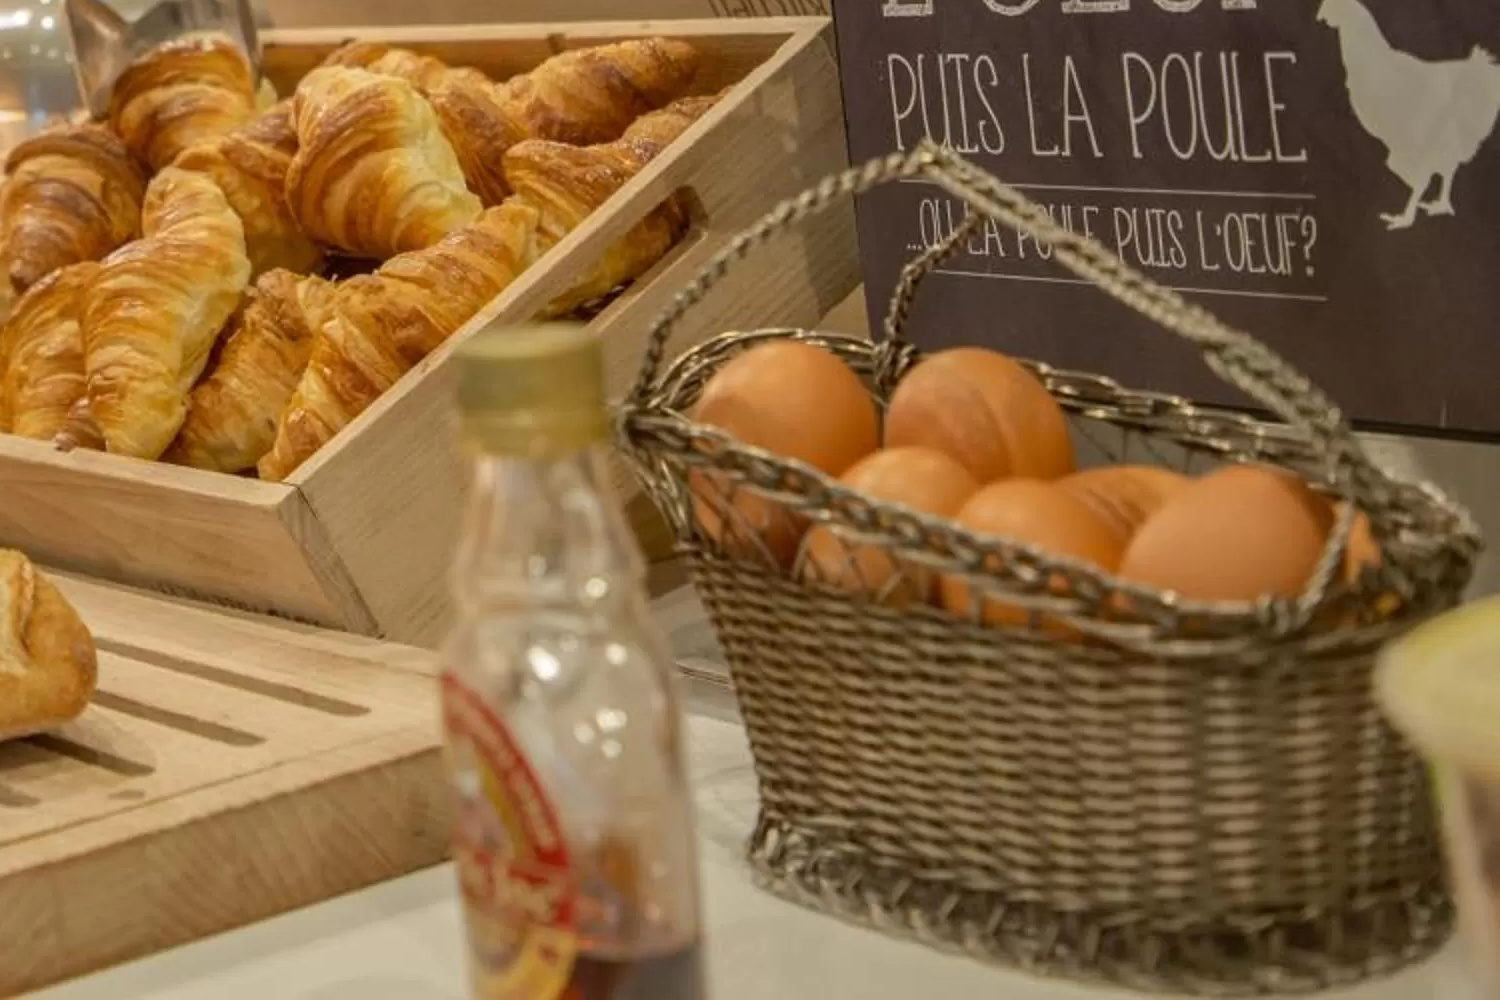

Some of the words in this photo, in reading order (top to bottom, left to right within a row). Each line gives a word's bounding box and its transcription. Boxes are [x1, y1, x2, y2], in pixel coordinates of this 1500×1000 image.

[887, 53, 1005, 155] PUIS
[1022, 52, 1104, 158] LA
[1122, 50, 1307, 163] POULE
[1113, 206, 1187, 269] PUIS
[1196, 209, 1317, 278] L'OEUF?
